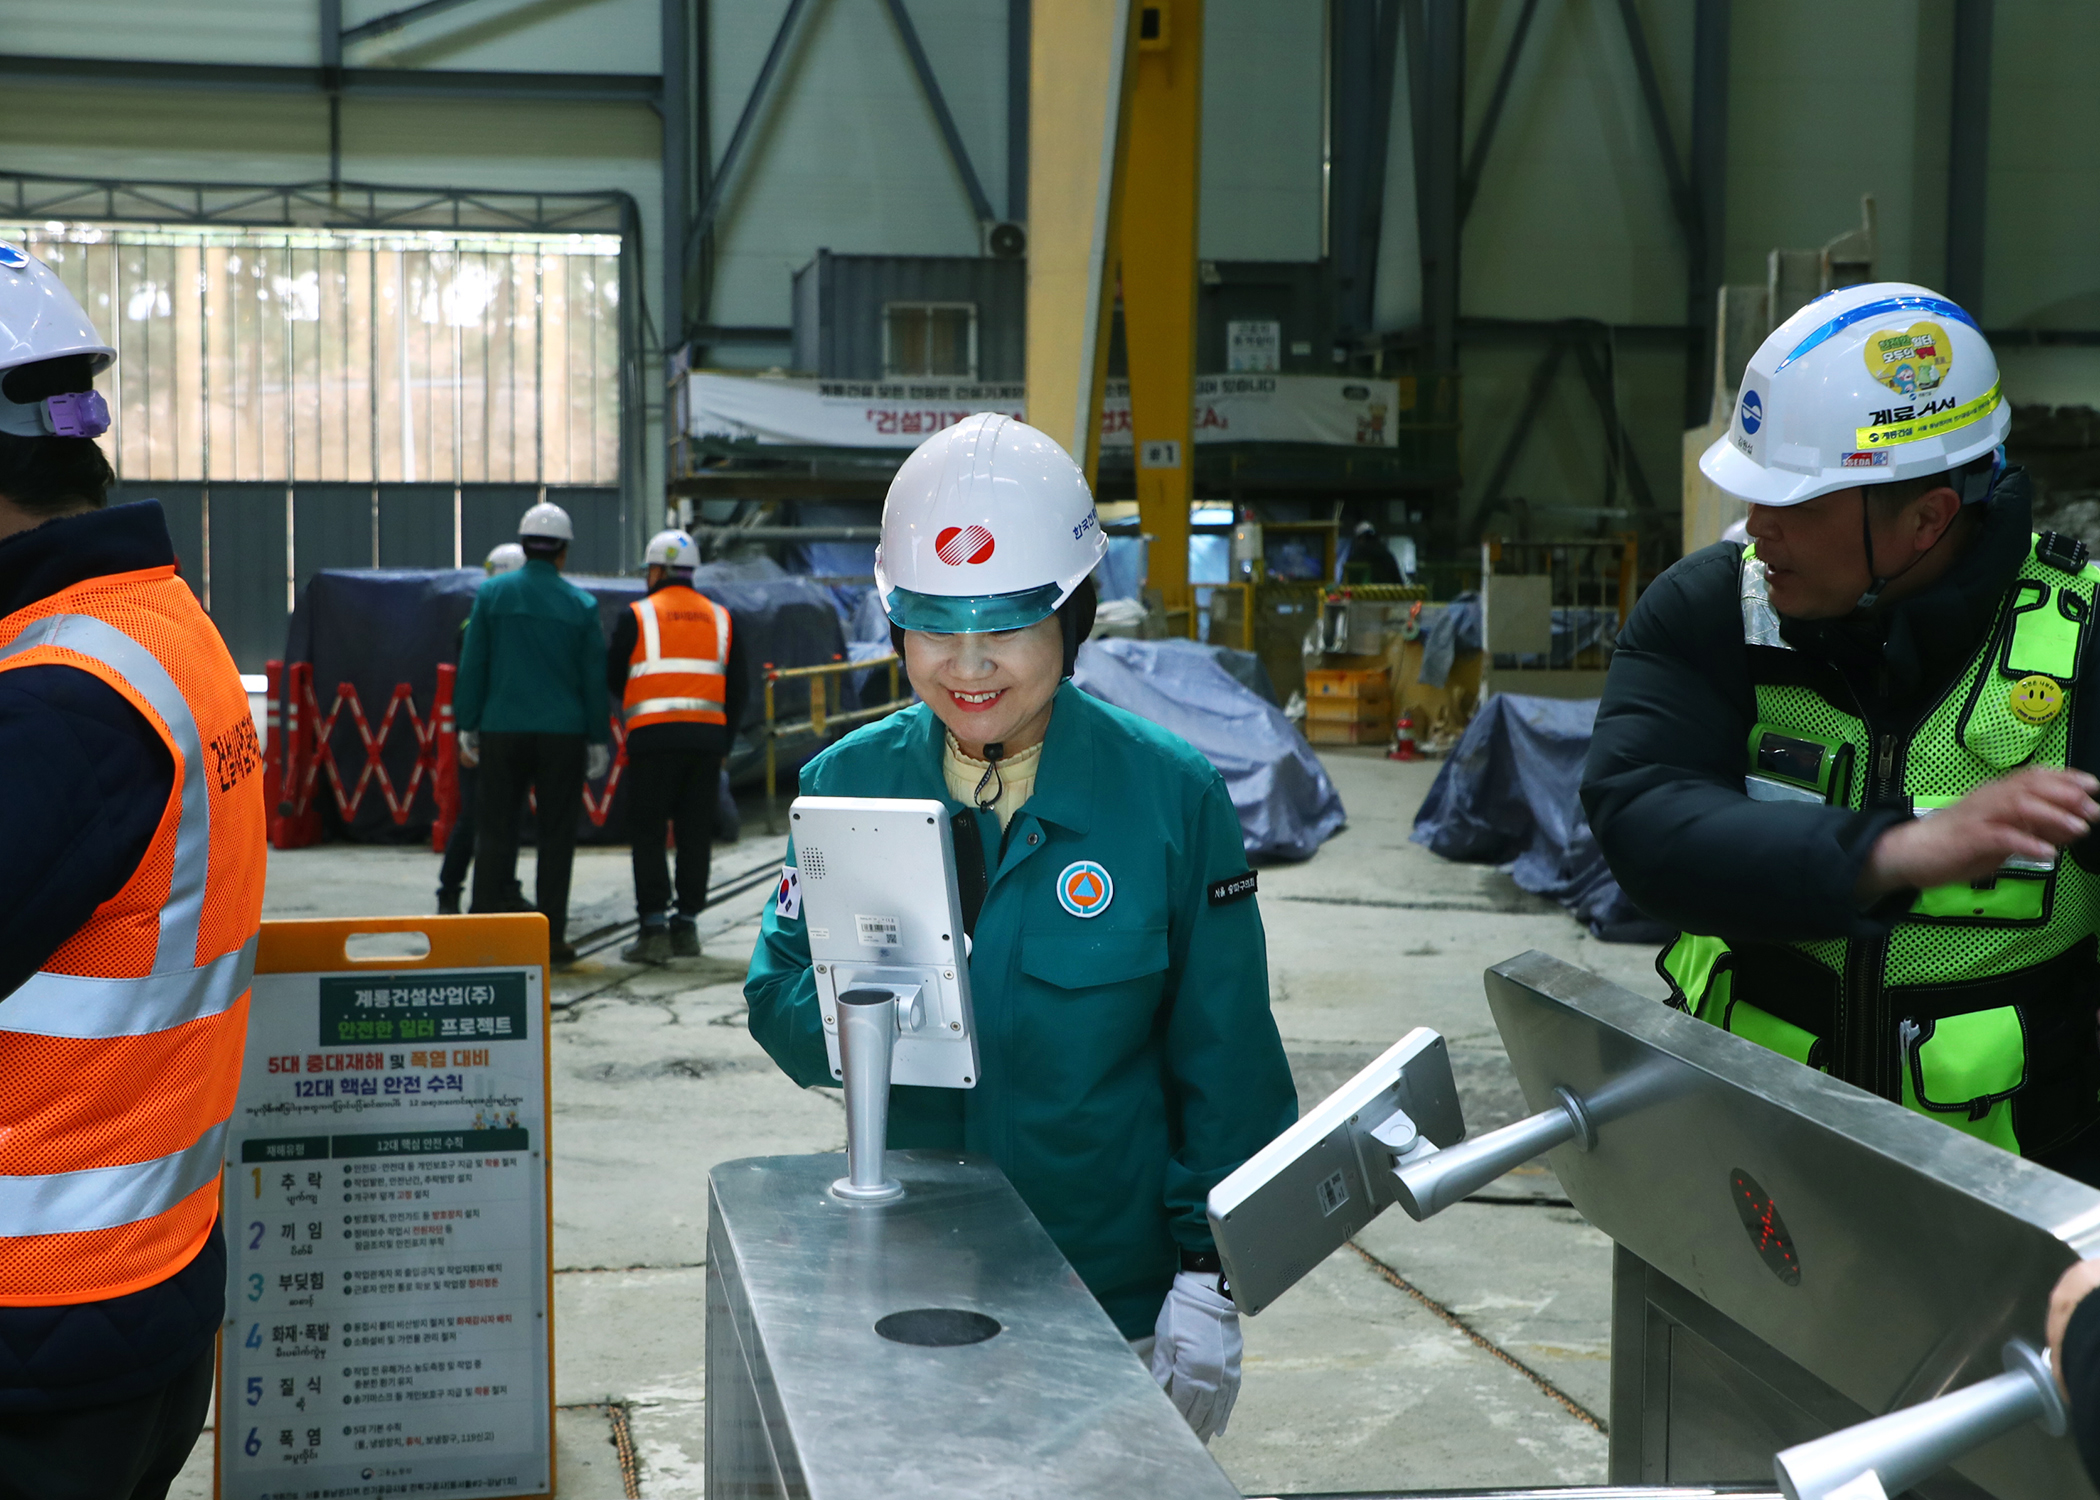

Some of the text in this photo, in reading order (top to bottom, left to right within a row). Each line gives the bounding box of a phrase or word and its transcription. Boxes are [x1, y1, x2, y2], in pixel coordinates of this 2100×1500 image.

[1149, 446, 1174, 462] #1
[354, 985, 495, 1009] 계룡건설산업(주)
[337, 1016, 512, 1040] 안전한 일터 프로젝트
[268, 1048, 490, 1074] 5대 중대재해 및 폭염 대비
[294, 1073, 464, 1098] 12대 핵심 안전 수칙
[377, 1136, 464, 1151] 12대 핵심 안전 수칙
[251, 1167, 261, 1200] 1
[249, 1221, 266, 1250] 2
[248, 1273, 265, 1303] 3
[245, 1322, 263, 1350] 4
[246, 1377, 263, 1407] 5
[244, 1426, 262, 1457] 6
